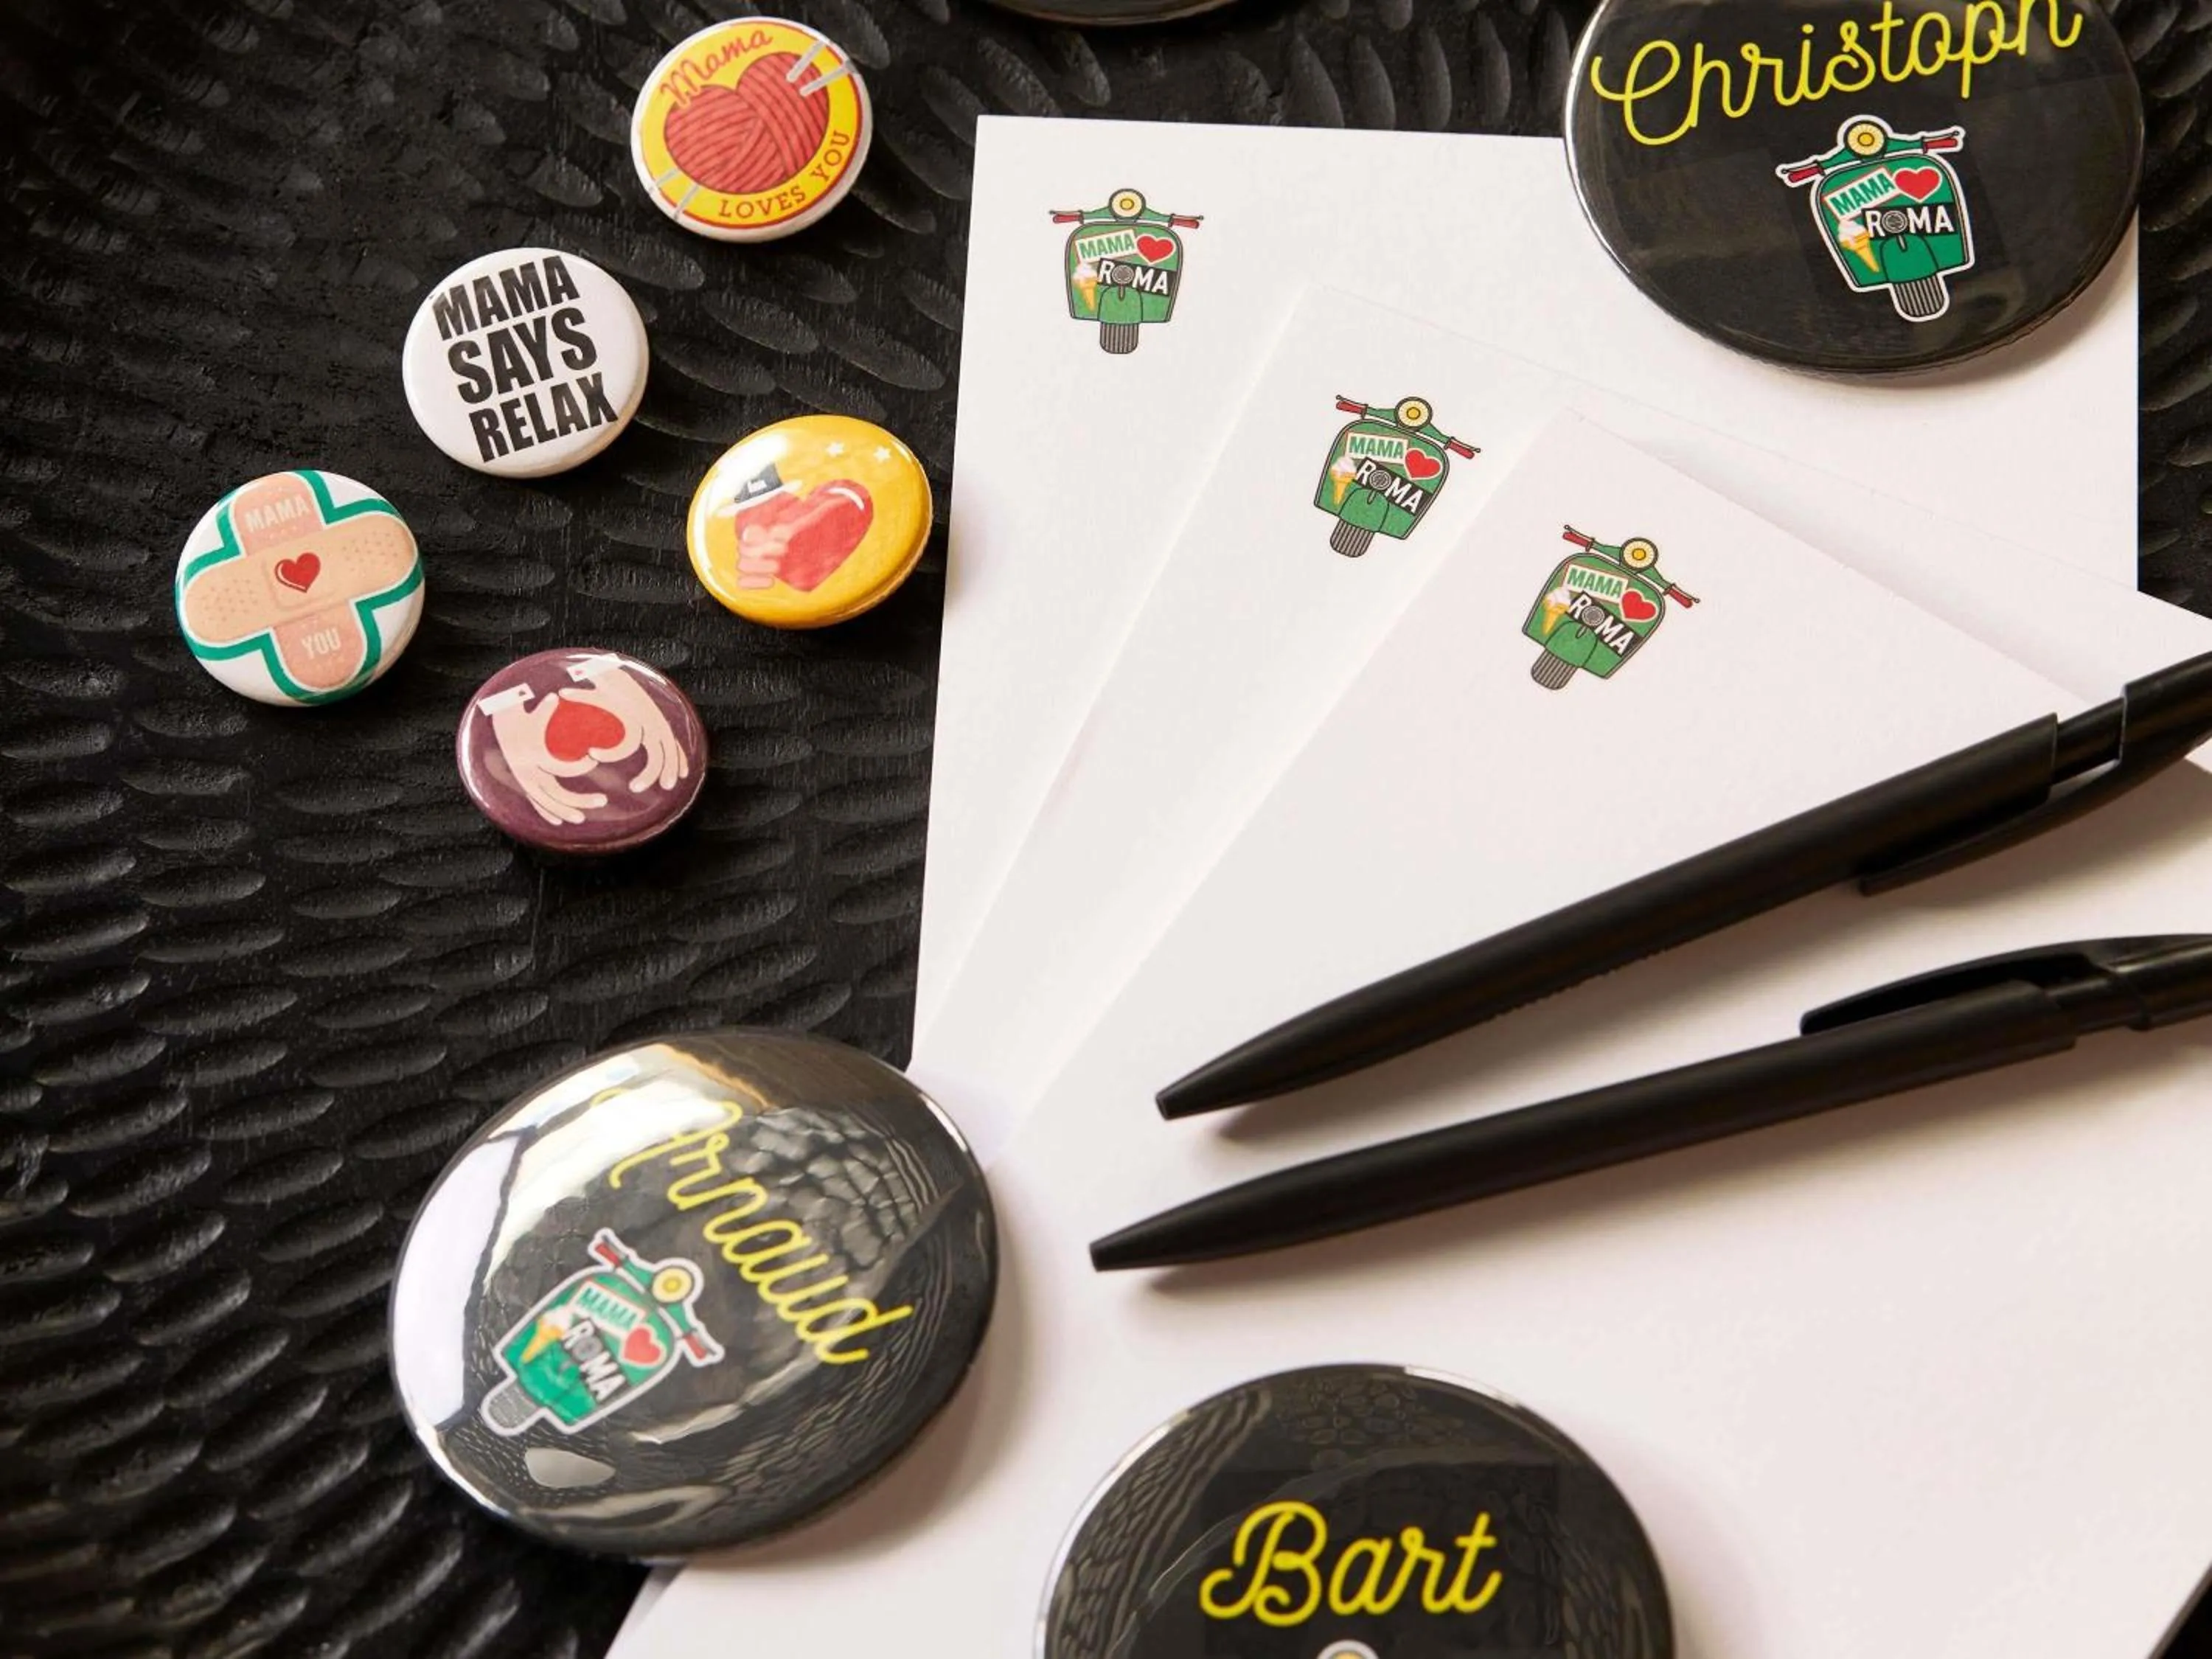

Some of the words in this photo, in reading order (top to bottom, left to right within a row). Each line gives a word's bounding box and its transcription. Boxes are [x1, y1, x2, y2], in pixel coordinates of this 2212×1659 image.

[659, 29, 774, 108] Mama
[1590, 0, 2083, 146] Christoph
[718, 185, 807, 219] LOVES
[810, 131, 851, 183] YOU
[1829, 171, 1897, 216] MAMA
[1078, 233, 1136, 259] MAMA
[1865, 204, 1955, 238] ROMA
[429, 255, 581, 341] MAMA
[1097, 259, 1169, 296] ROMA
[447, 306, 599, 404] SAYS
[467, 371, 619, 464] RELAX
[1348, 435, 1405, 459] MAMA
[1354, 459, 1425, 514] ROMA
[244, 495, 311, 533] MAMA
[1566, 566, 1627, 599] MAMA
[301, 627, 343, 660] YOU
[1568, 594, 1635, 655] ROMA
[575, 1287, 639, 1332] MAMA
[1198, 1500, 1503, 1627] Bart
